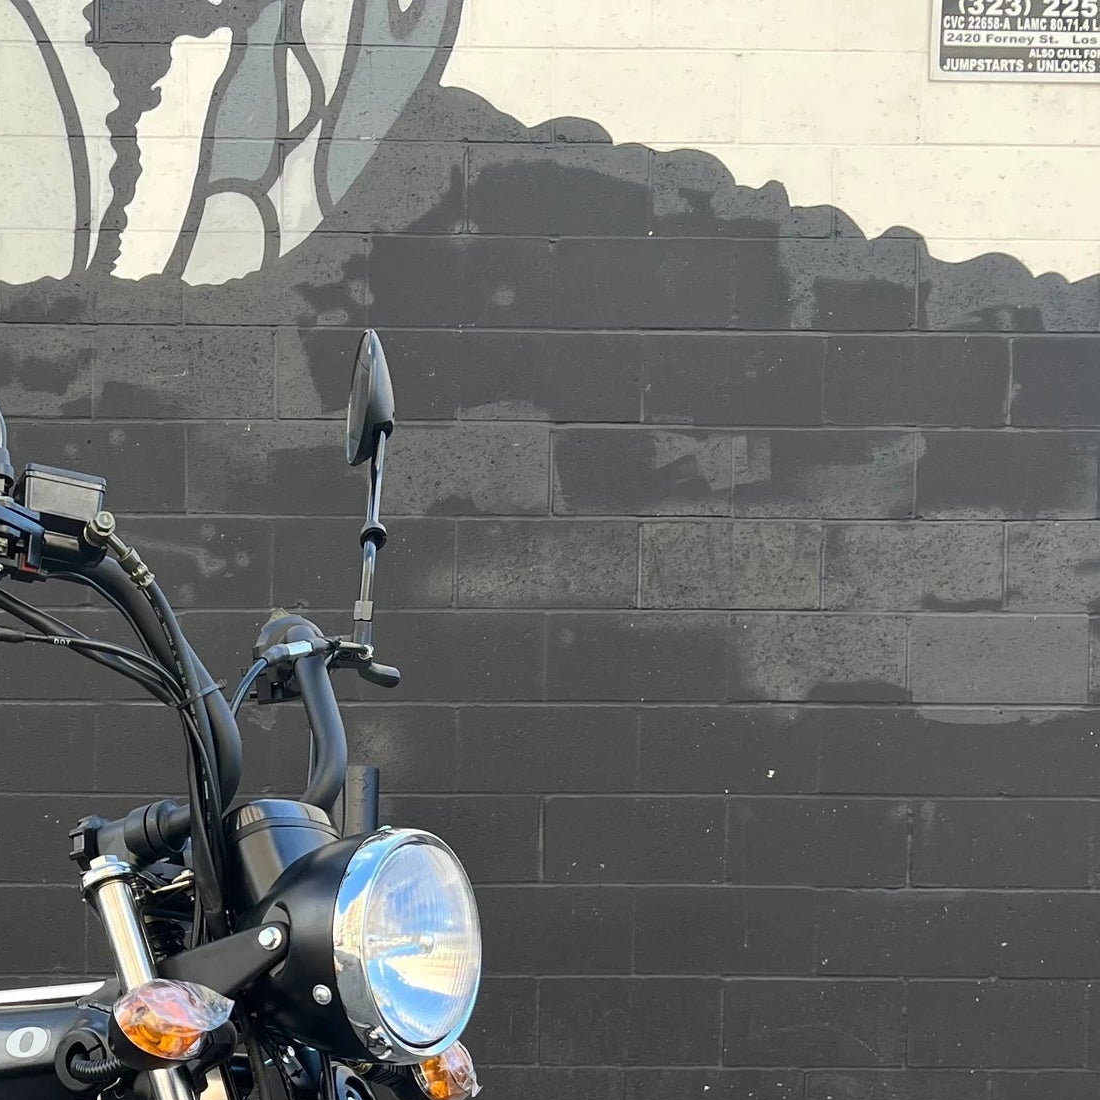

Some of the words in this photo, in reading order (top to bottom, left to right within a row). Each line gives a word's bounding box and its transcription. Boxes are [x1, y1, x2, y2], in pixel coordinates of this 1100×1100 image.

[943, 15, 965, 29] CVC
[967, 16, 1011, 30] 22658-A
[1017, 17, 1047, 30] LAMC
[1050, 18, 1090, 31] 80.71.4
[946, 33, 981, 43] 2420
[986, 33, 1035, 46] Forney
[1039, 35, 1059, 44] St.
[1072, 35, 1098, 44] Los
[1029, 48, 1055, 58] ALSO
[1056, 49, 1082, 59] CALL
[943, 58, 1024, 71] JUMPSTARTS
[1036, 60, 1096, 72] UNLOCKS
